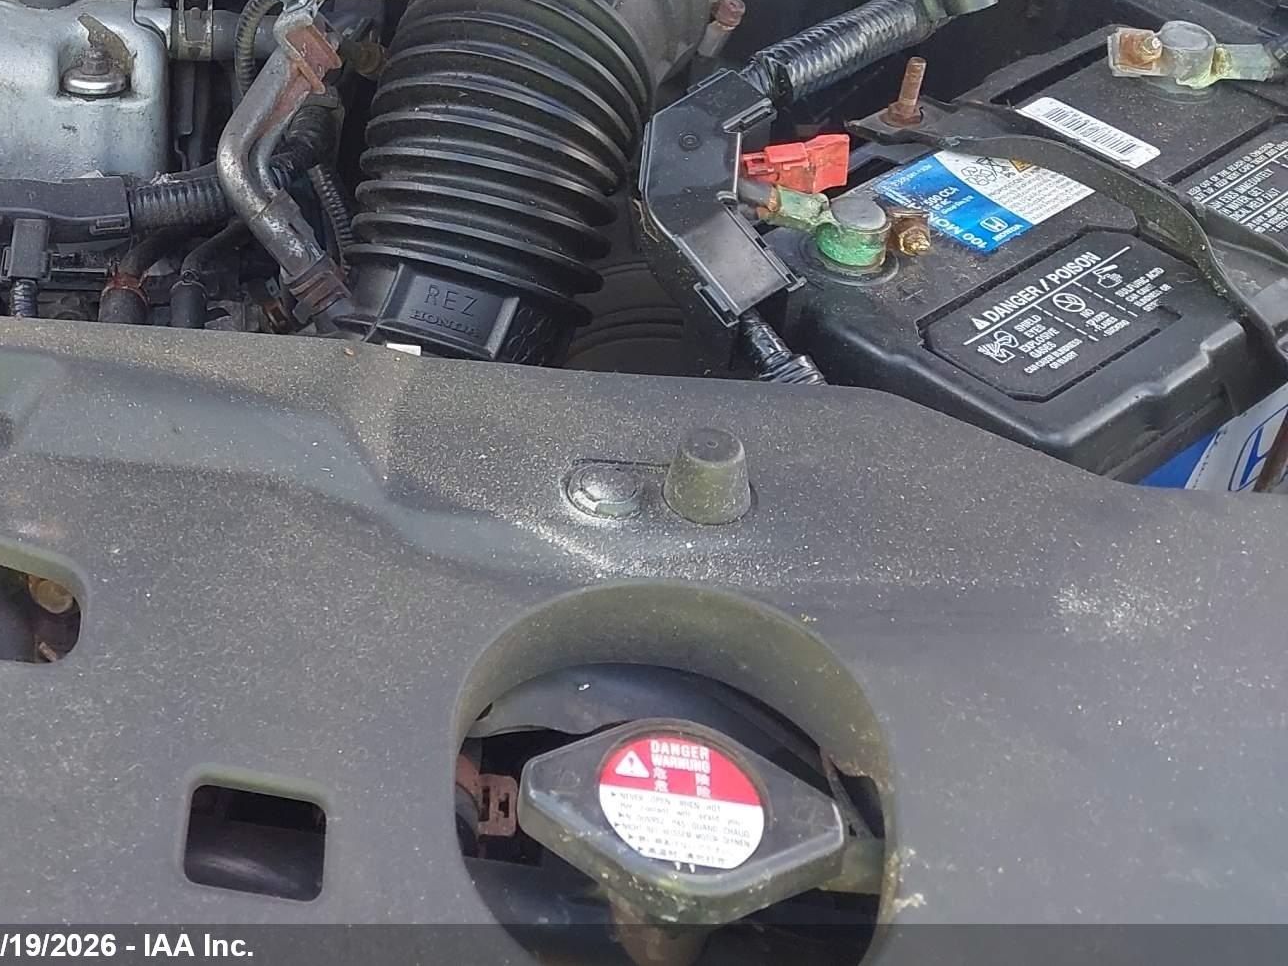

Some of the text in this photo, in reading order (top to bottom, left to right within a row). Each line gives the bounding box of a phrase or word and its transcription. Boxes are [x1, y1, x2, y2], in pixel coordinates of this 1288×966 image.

[925, 192, 943, 206] 500
[937, 186, 960, 202] CCA
[960, 232, 988, 250] 100
[990, 224, 1024, 243] HONDA
[982, 285, 1043, 323] DANGER
[1048, 251, 1102, 285] POISON
[1114, 266, 1166, 298] SULFURIC ACID
[423, 284, 478, 317] REZ
[1013, 313, 1043, 333] SHIELD
[1079, 307, 1095, 319] NO
[410, 308, 481, 339] HONDA
[1023, 323, 1047, 339] EYES
[1017, 327, 1061, 354] EXPLOSIVE
[1028, 340, 1057, 359] GASES
[649, 739, 710, 759] DANGER
